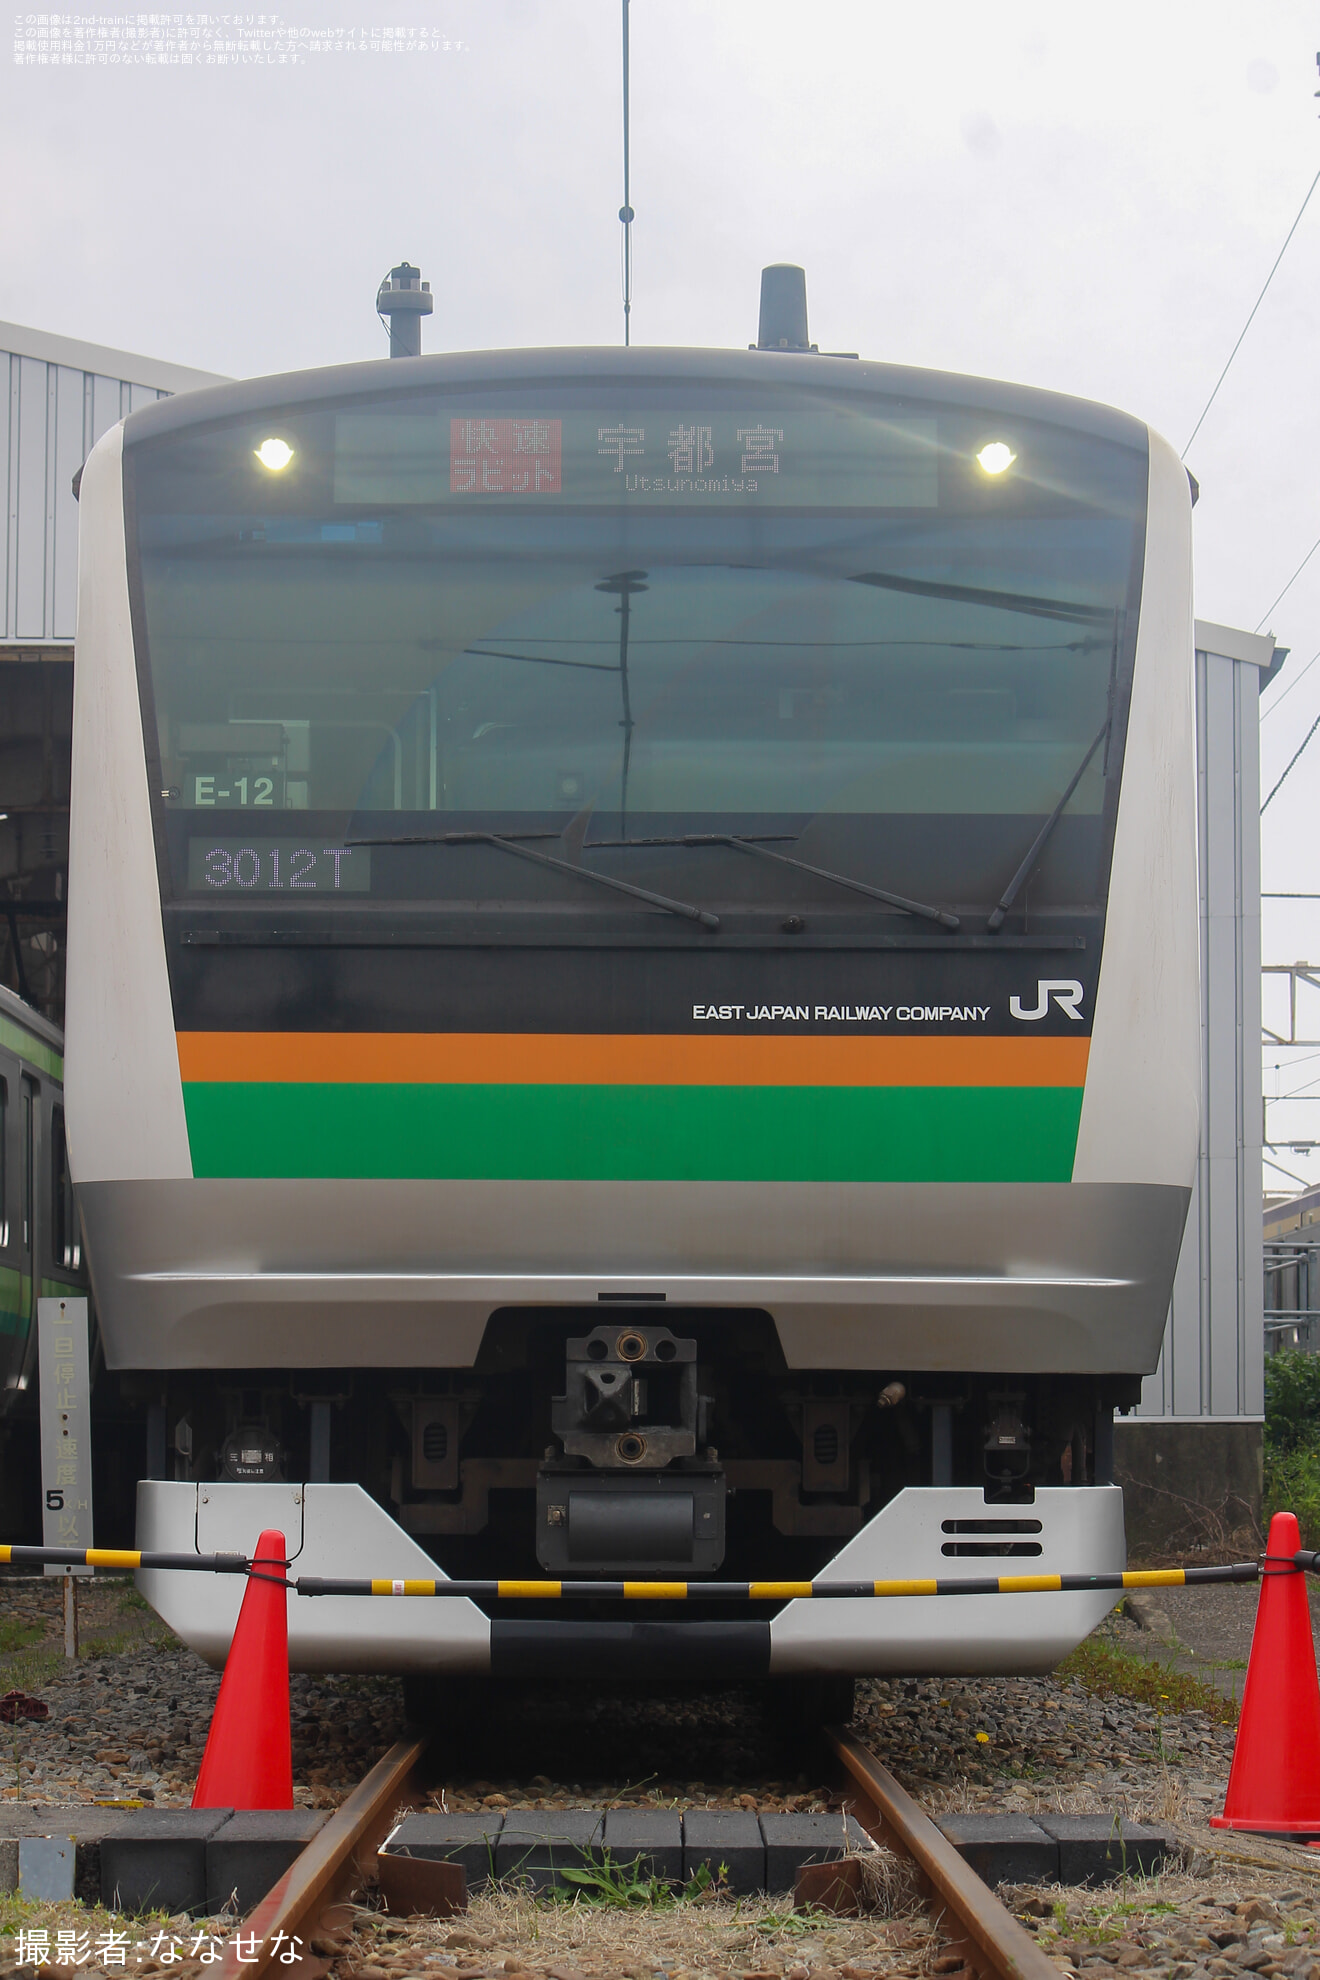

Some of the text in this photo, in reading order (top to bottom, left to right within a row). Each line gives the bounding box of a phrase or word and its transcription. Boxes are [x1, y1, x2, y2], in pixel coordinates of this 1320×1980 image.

[461, 420, 551, 455] 快速
[598, 424, 785, 474] 宇都宮
[453, 458, 555, 492] ラビット
[625, 475, 759, 493] Utsunomiya
[195, 776, 274, 805] E-12
[205, 848, 352, 888] 3012T
[692, 1004, 991, 1021] EAST JAPAN RAILWAY COMPANY
[1009, 979, 1085, 1021] JR
